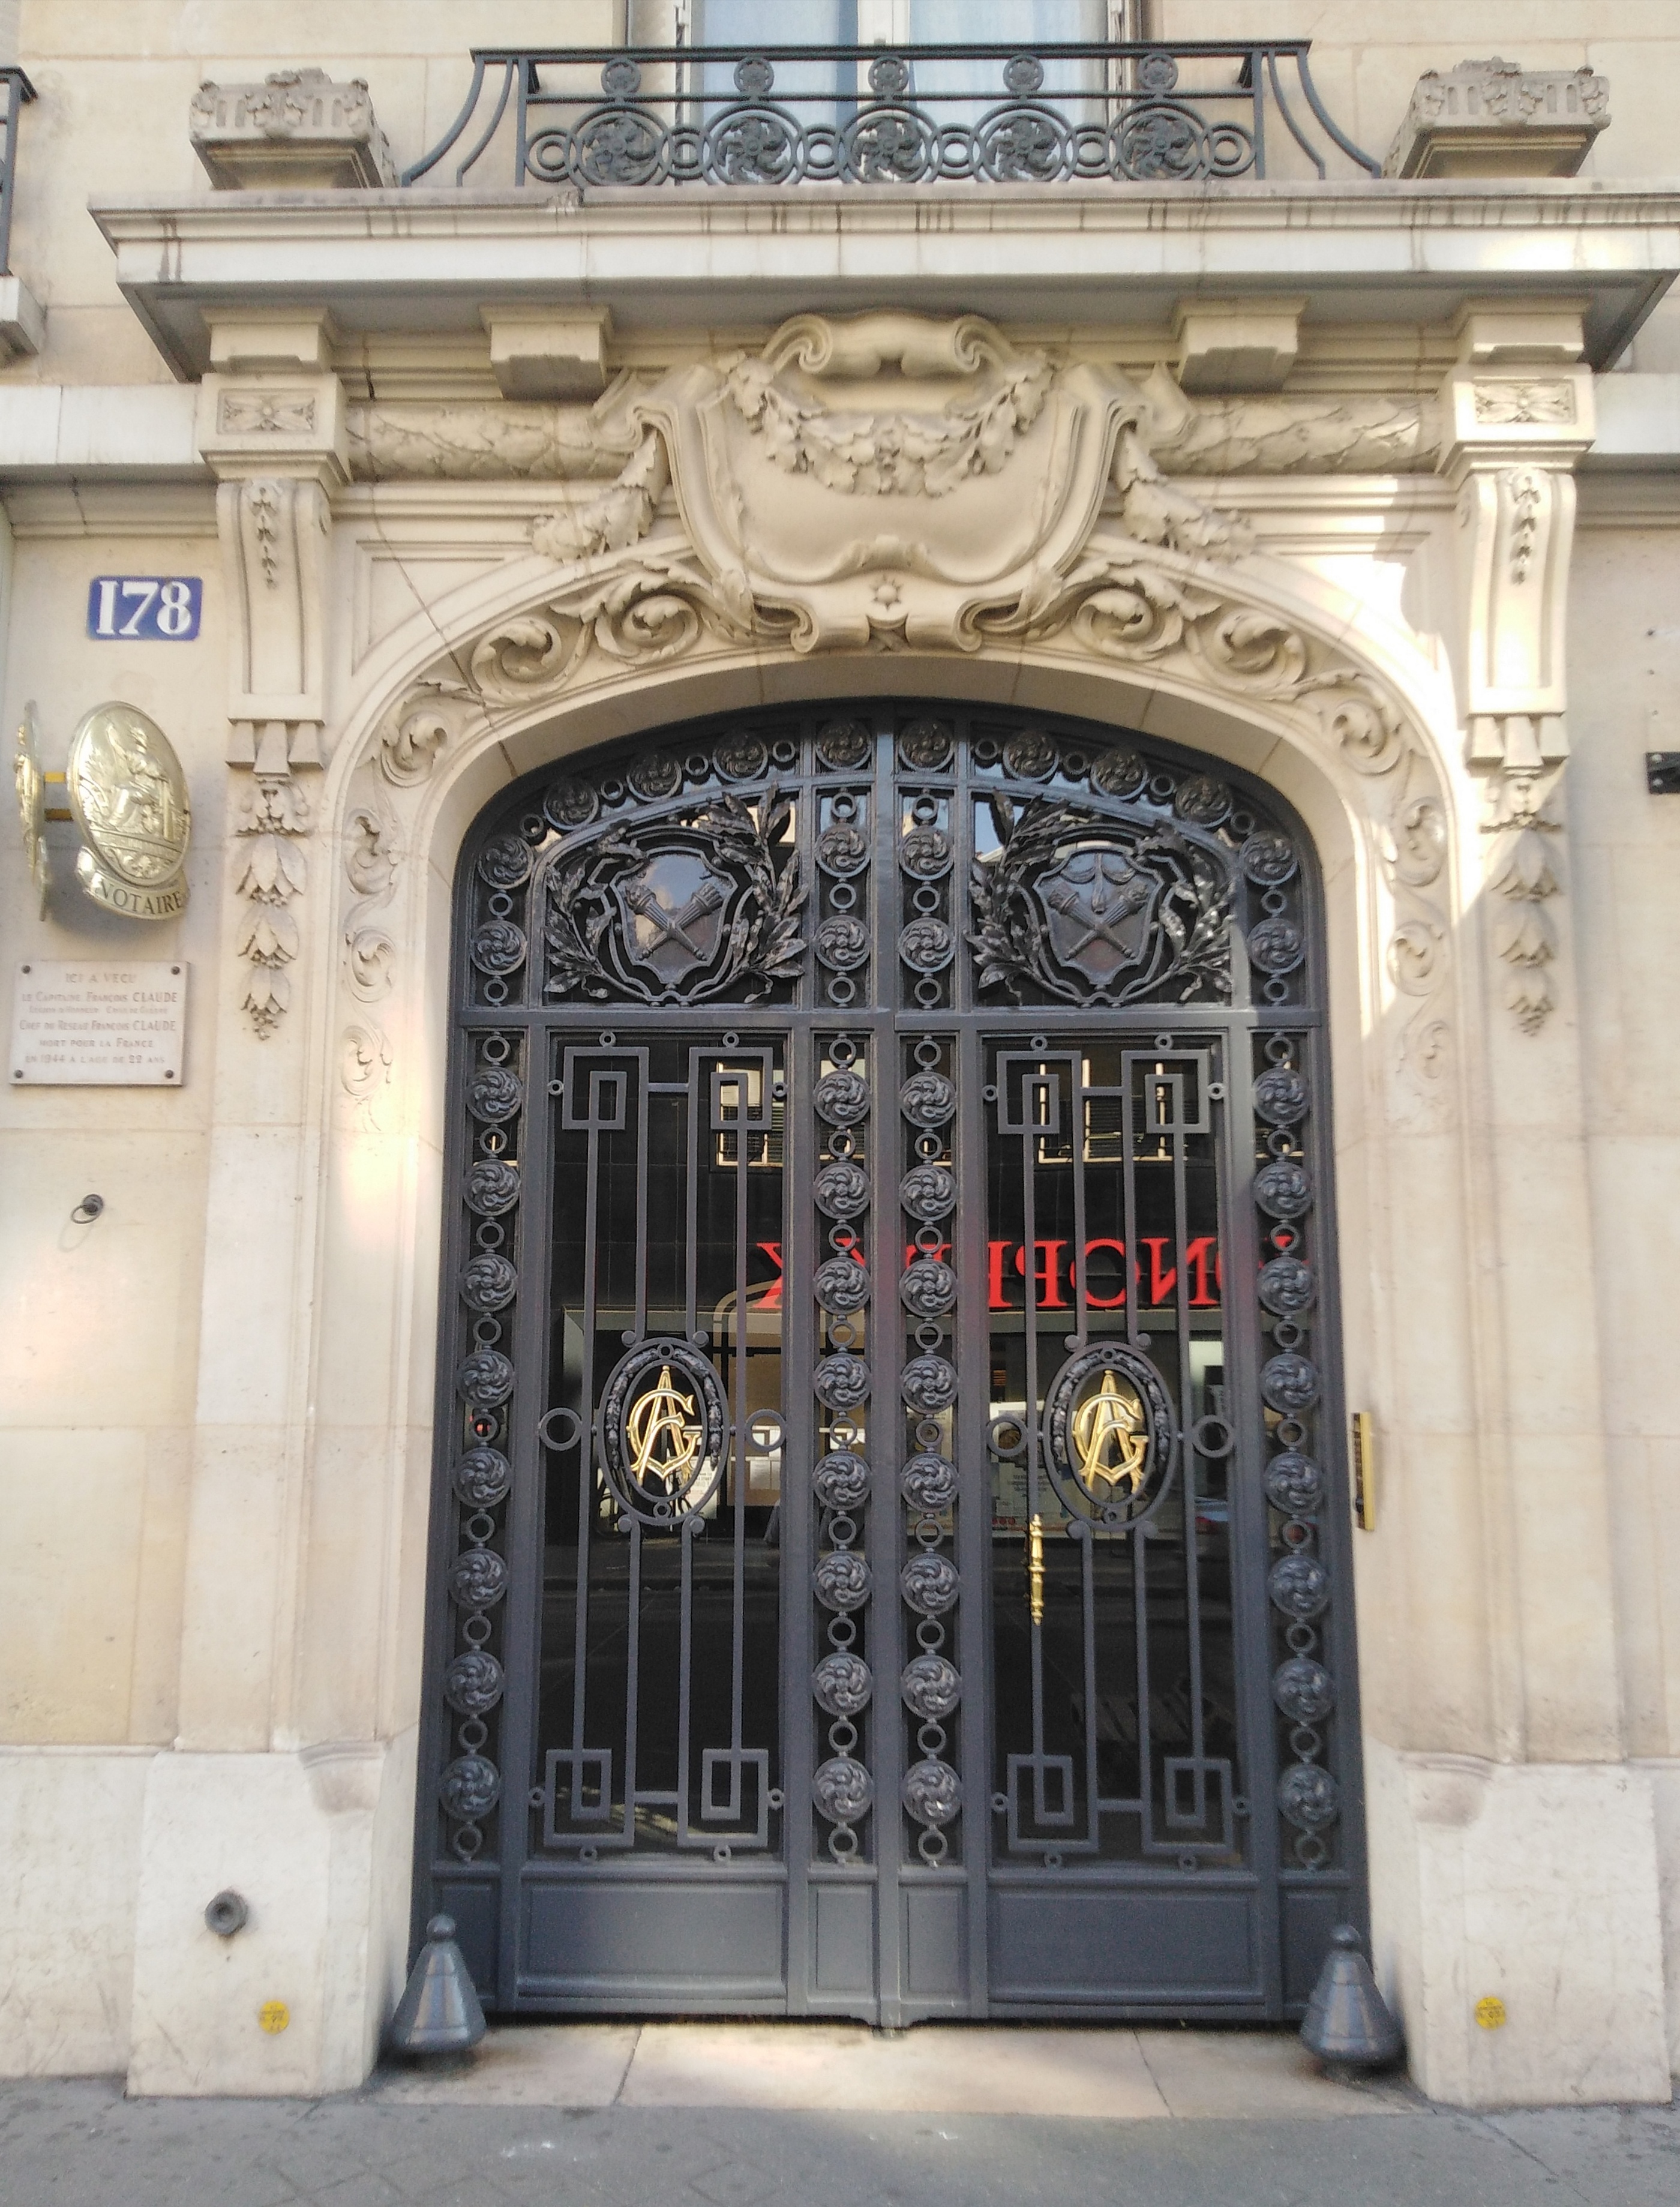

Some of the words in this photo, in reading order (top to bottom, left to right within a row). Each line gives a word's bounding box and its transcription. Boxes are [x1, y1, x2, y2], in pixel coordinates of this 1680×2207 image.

[96, 580, 192, 636] 178
[95, 878, 182, 914] NOTAIRE
[65, 973, 82, 983] ICI
[89, 974, 98, 983] A
[133, 992, 178, 1003] CLAUDE
[132, 1020, 176, 1031] CLAUDE
[116, 1037, 154, 1048] FRANCE
[41, 1054, 65, 1063] 1944
